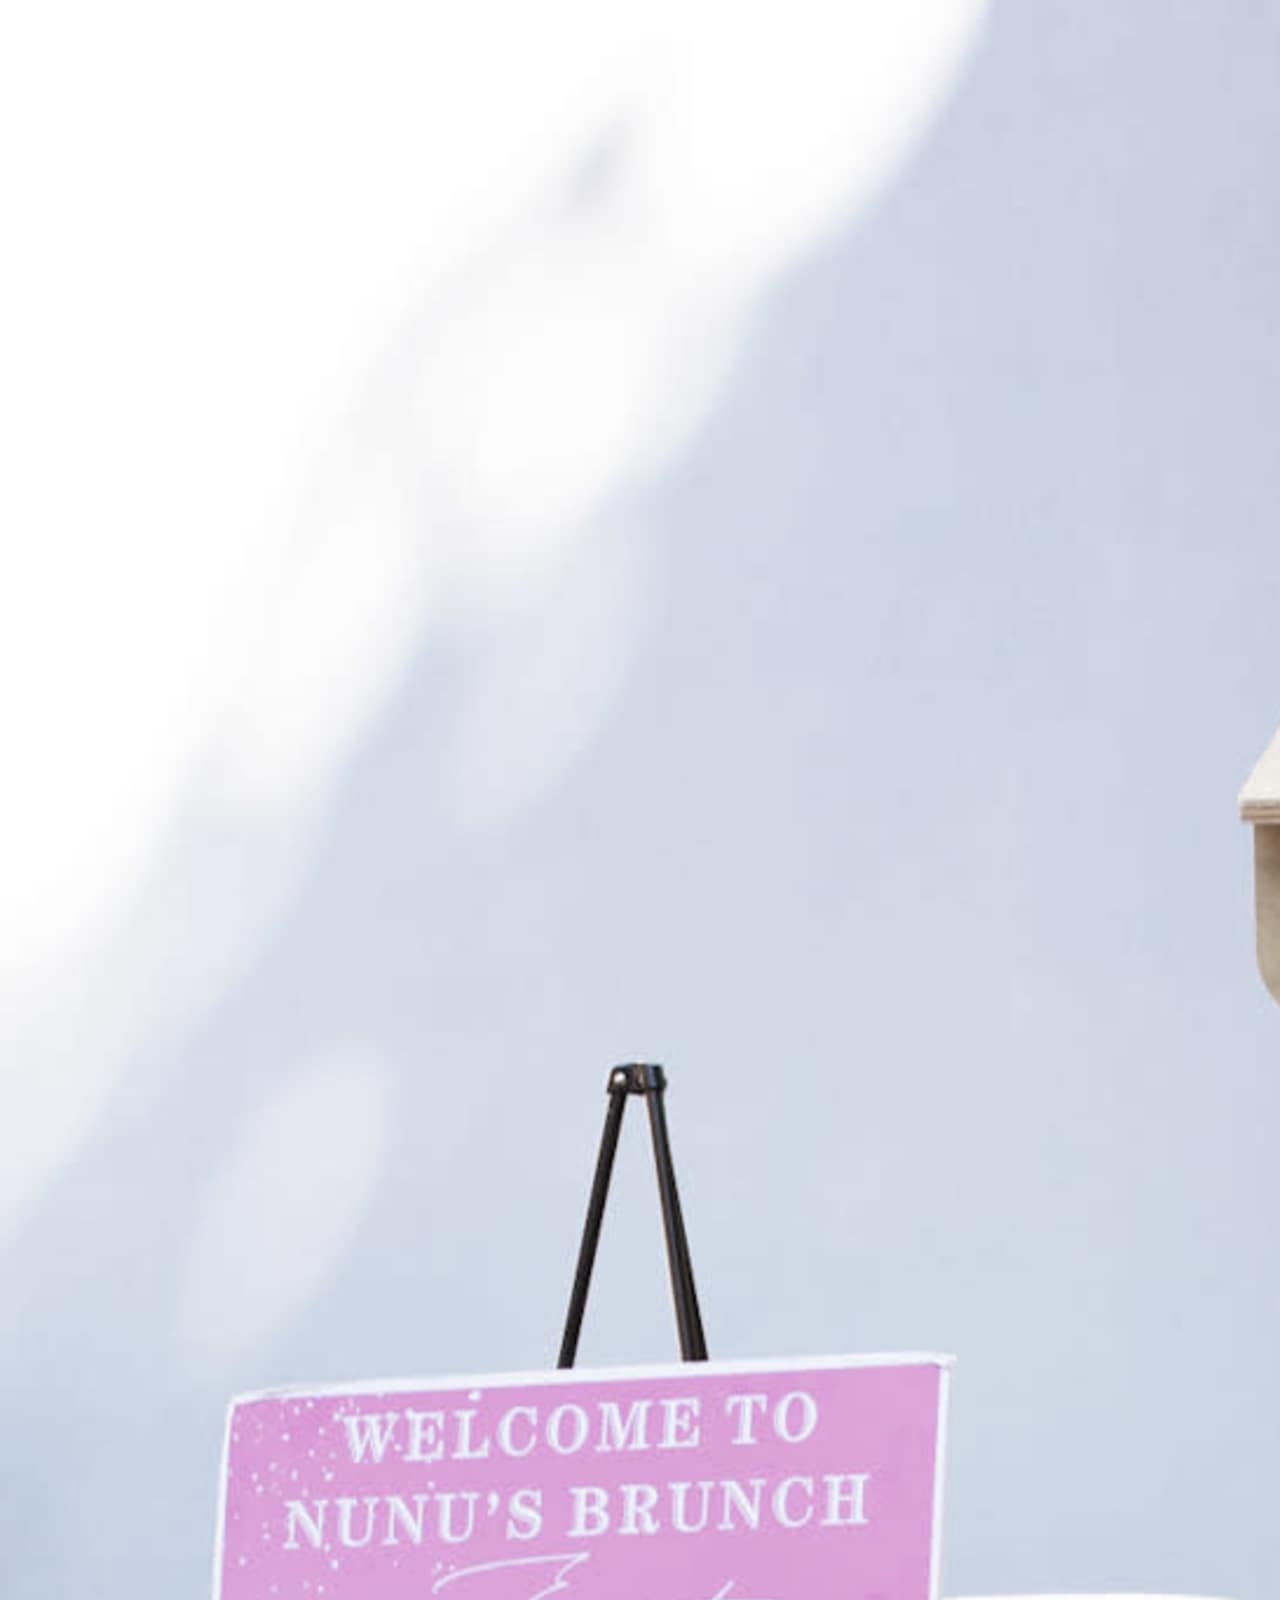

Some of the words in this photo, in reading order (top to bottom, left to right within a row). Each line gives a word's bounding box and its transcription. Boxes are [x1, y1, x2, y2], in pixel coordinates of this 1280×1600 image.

[343, 1398, 702, 1464] WELCOME
[727, 1392, 818, 1446] TO
[283, 1489, 544, 1549] NUNU'S
[567, 1473, 871, 1538] BRUNCH
